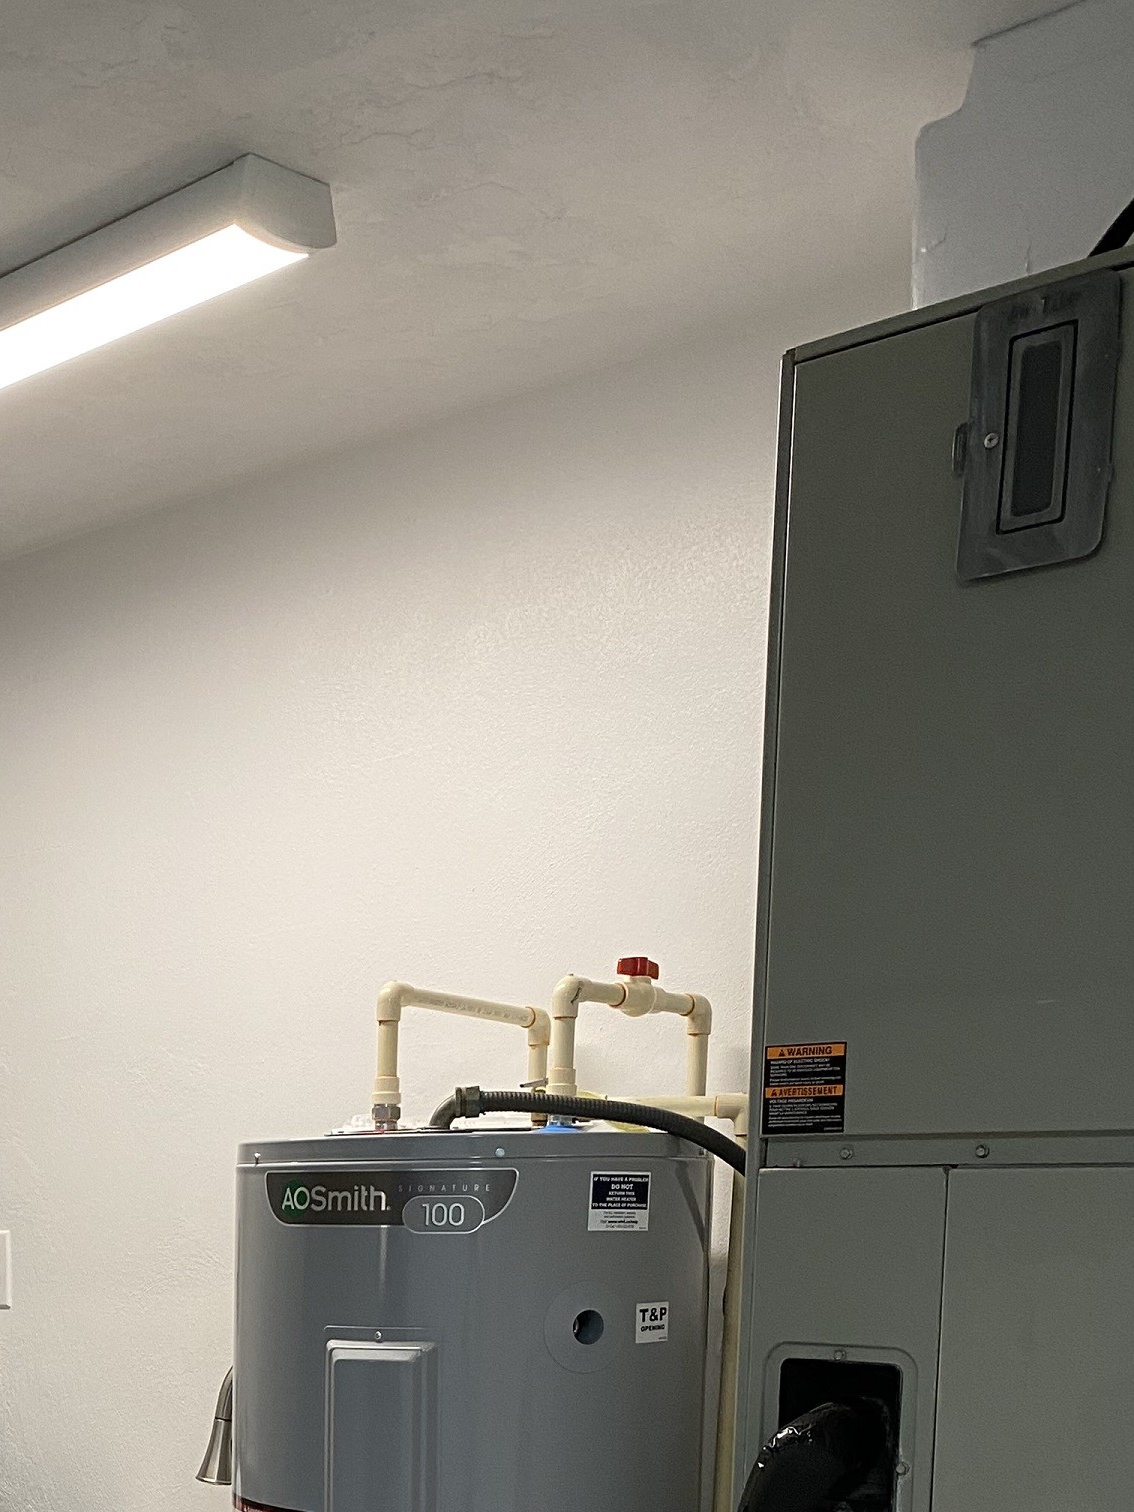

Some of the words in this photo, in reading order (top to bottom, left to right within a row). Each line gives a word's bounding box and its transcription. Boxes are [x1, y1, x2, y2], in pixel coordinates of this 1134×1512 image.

[787, 1046, 833, 1056] WARNING
[779, 1086, 837, 1096] AVERTISSEMENT
[398, 1184, 491, 1193] SIGNATURE
[422, 1202, 465, 1227] 100
[639, 1306, 667, 1323] T&P
